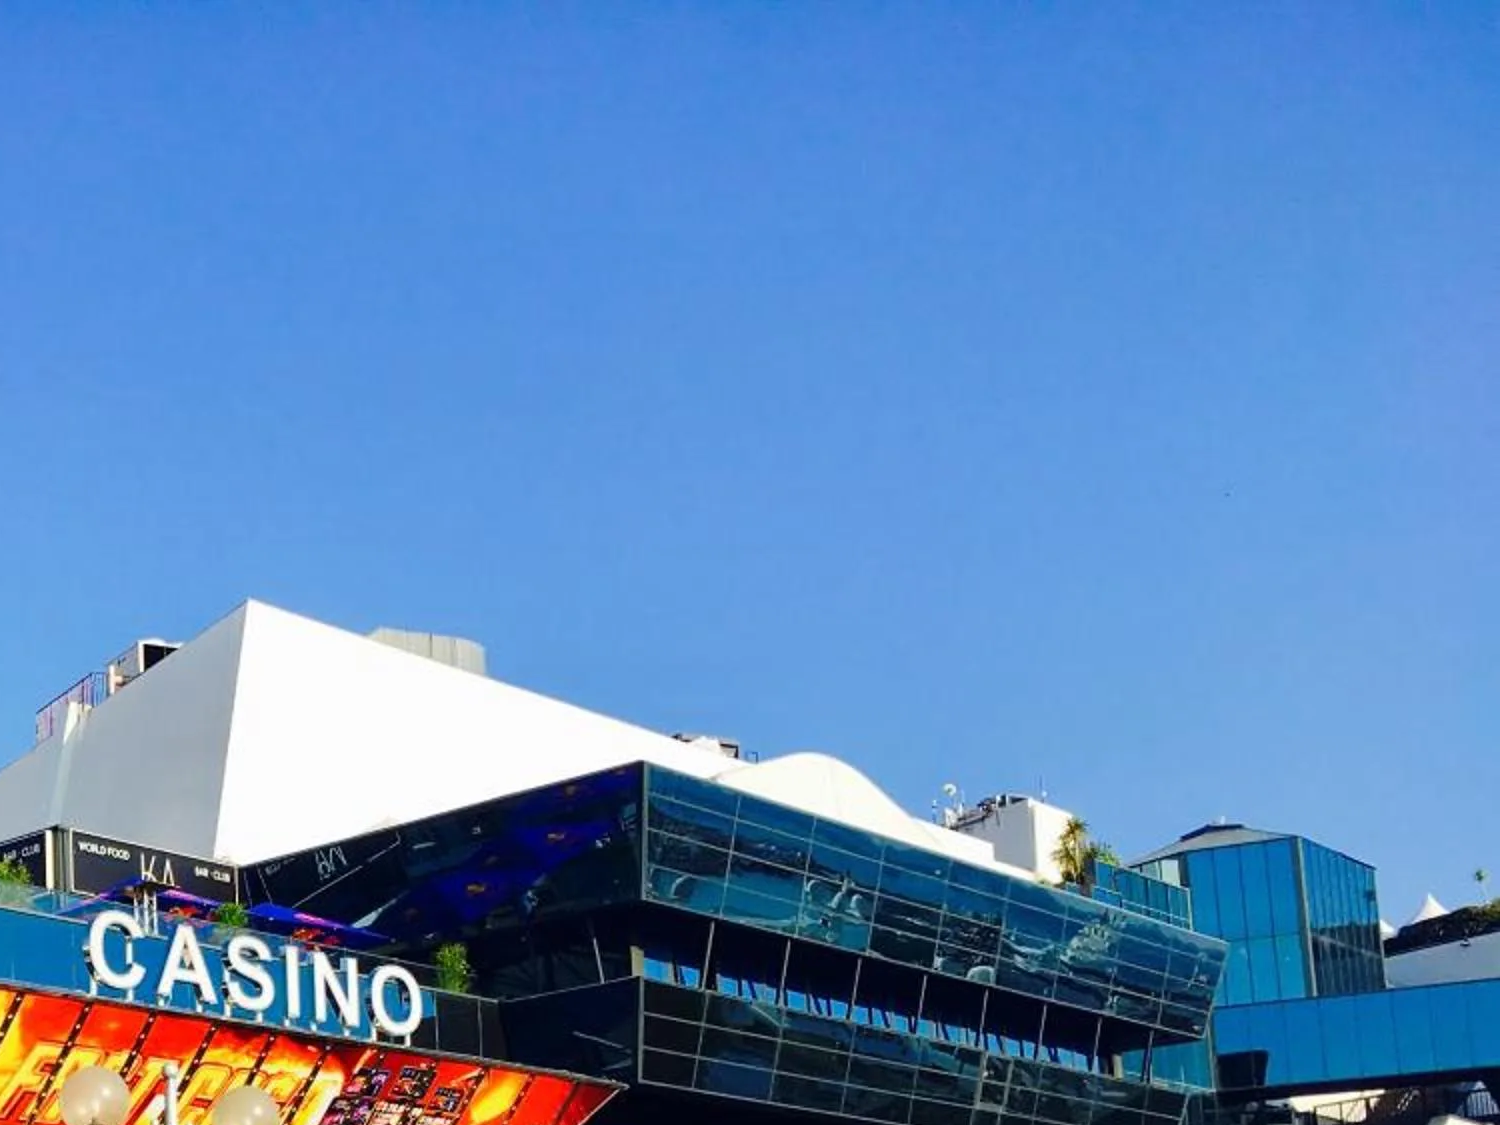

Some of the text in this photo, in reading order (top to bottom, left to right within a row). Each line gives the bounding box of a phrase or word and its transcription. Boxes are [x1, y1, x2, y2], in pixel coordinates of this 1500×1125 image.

[78, 841, 131, 861] WORLD FOOD
[86, 909, 423, 1037] CASINO
